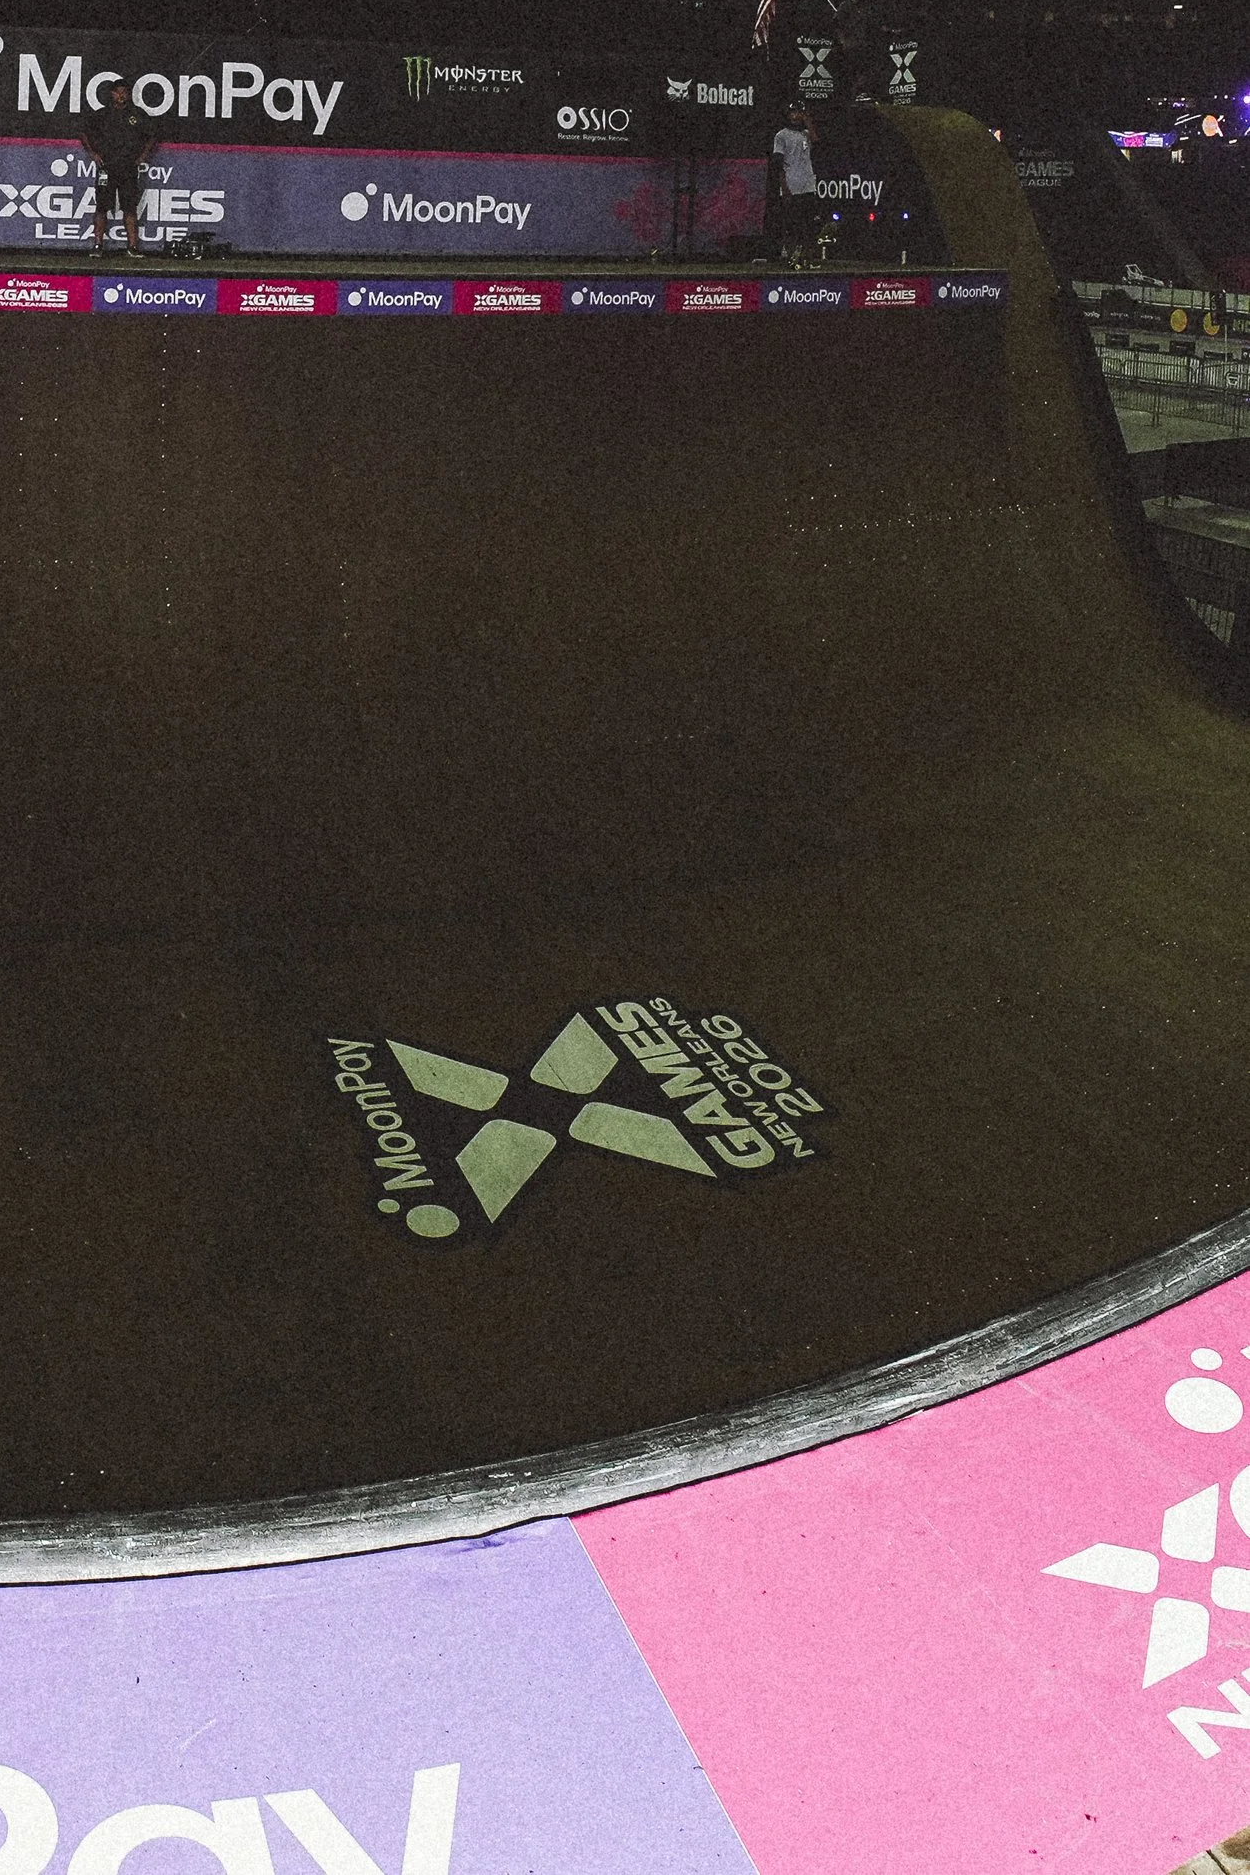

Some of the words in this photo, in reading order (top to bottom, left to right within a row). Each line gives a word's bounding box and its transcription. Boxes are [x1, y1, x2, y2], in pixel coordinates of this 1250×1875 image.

[434, 65, 524, 84] MONSTER
[798, 79, 834, 88] GAMES
[17, 53, 344, 135] MoonPay
[448, 84, 511, 93] ENERGY
[696, 83, 754, 106] Bobcat
[557, 106, 630, 131] OSSIO
[77, 160, 174, 184] MPay
[815, 173, 883, 206] oonPay
[1020, 178, 1062, 188] EAGUE
[383, 192, 532, 230] MoonPay
[35, 223, 189, 242] LEAGUE
[16, 280, 50, 288] MoonPay
[265, 285, 298, 294] MoonPay
[951, 285, 1001, 299] MoonPay
[126, 288, 206, 308] MoonPay
[368, 292, 443, 309] MoonPay
[589, 291, 656, 308] MoonPay
[784, 288, 842, 305] MoonPay
[649, 997, 754, 1098] ORLEANS
[701, 1015, 824, 1117] 2026
[596, 1002, 776, 1169] GAMES
[327, 1037, 434, 1191] MoonPay
[744, 1101, 815, 1159] NEW
